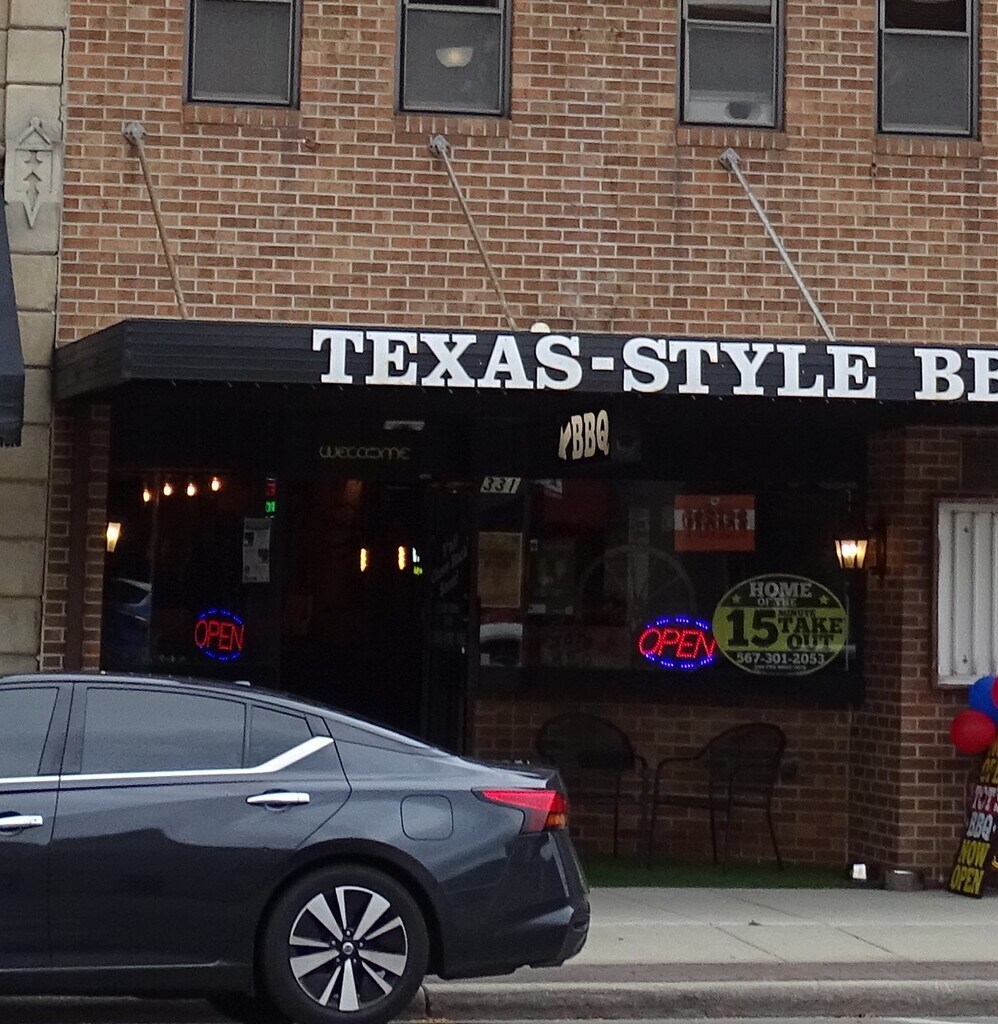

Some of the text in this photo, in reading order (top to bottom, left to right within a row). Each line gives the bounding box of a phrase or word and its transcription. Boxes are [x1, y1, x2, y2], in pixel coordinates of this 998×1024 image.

[311, 328, 877, 399] TEXAS-STYLE
[483, 477, 516, 493] 331
[749, 581, 813, 598] HOME
[775, 597, 798, 607] THE
[194, 617, 246, 652] OPEN
[726, 609, 778, 648] 15
[778, 617, 843, 634] TAKE
[638, 627, 716, 659] OPEN
[786, 634, 834, 650] OUT
[737, 651, 825, 665] 567-301-2053
[957, 839, 992, 869] NOW
[949, 864, 985, 897] OPEN
